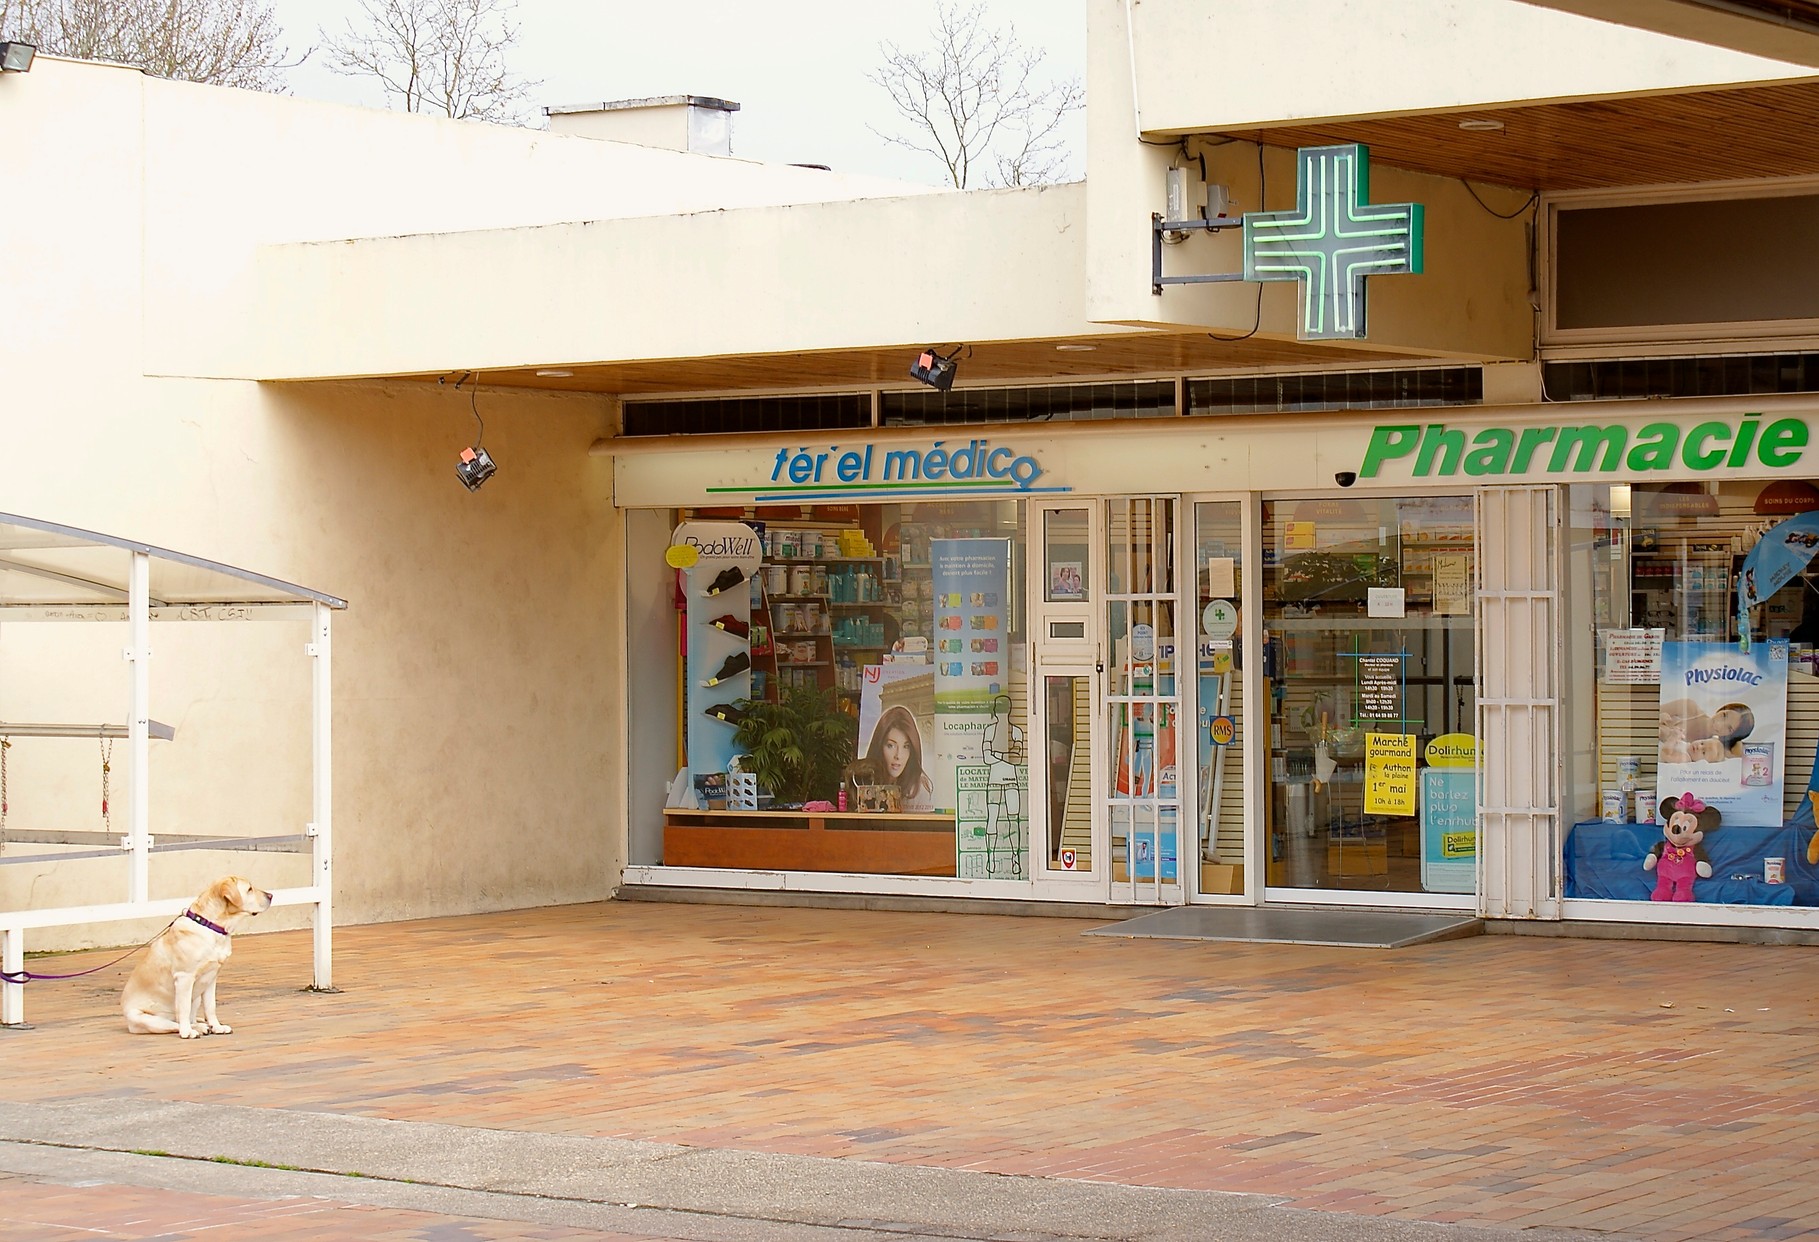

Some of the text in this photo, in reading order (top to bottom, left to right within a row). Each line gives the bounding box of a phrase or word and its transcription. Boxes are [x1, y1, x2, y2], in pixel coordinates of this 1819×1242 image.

[1358, 412, 1809, 478] Pharmacie
[684, 536, 753, 555] PodoWell
[865, 667, 881, 684] NJ
[1685, 664, 1763, 687] Physiolac
[1213, 725, 1232, 736] RMS
[1372, 736, 1409, 747] Marché
[1369, 748, 1412, 758] gourmand
[1383, 763, 1412, 772] Authon
[1762, 767, 1769, 776] 2
[1391, 772, 1409, 780] plaine
[1429, 777, 1444, 787] Ne
[1389, 784, 1407, 793] mai
[1374, 797, 1386, 805] 10h
